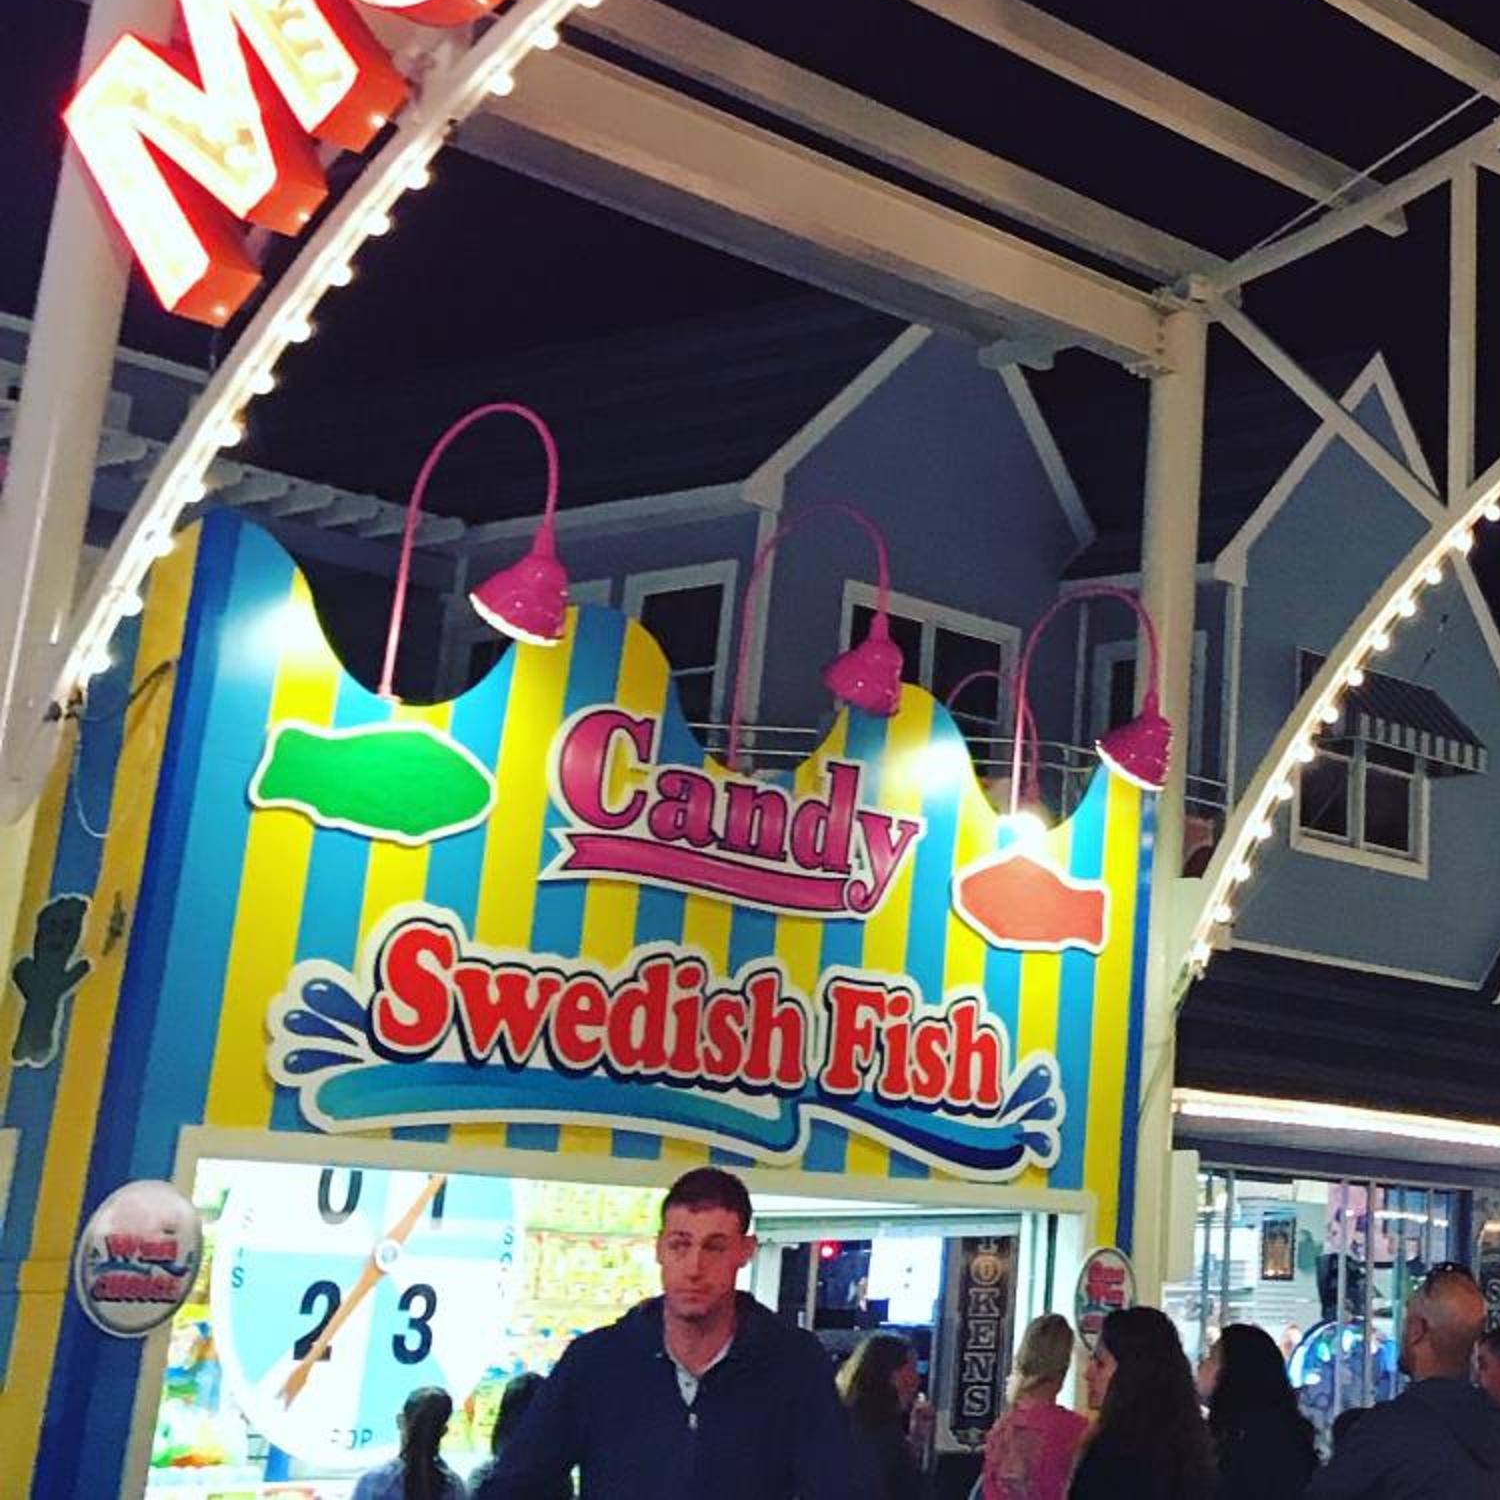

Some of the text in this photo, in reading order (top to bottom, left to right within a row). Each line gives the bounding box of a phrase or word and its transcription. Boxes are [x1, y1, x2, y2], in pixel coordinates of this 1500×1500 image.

[560, 709, 919, 912] Candy
[376, 920, 1002, 1113] Swedish Fish
[292, 1279, 438, 1365] 2 3
